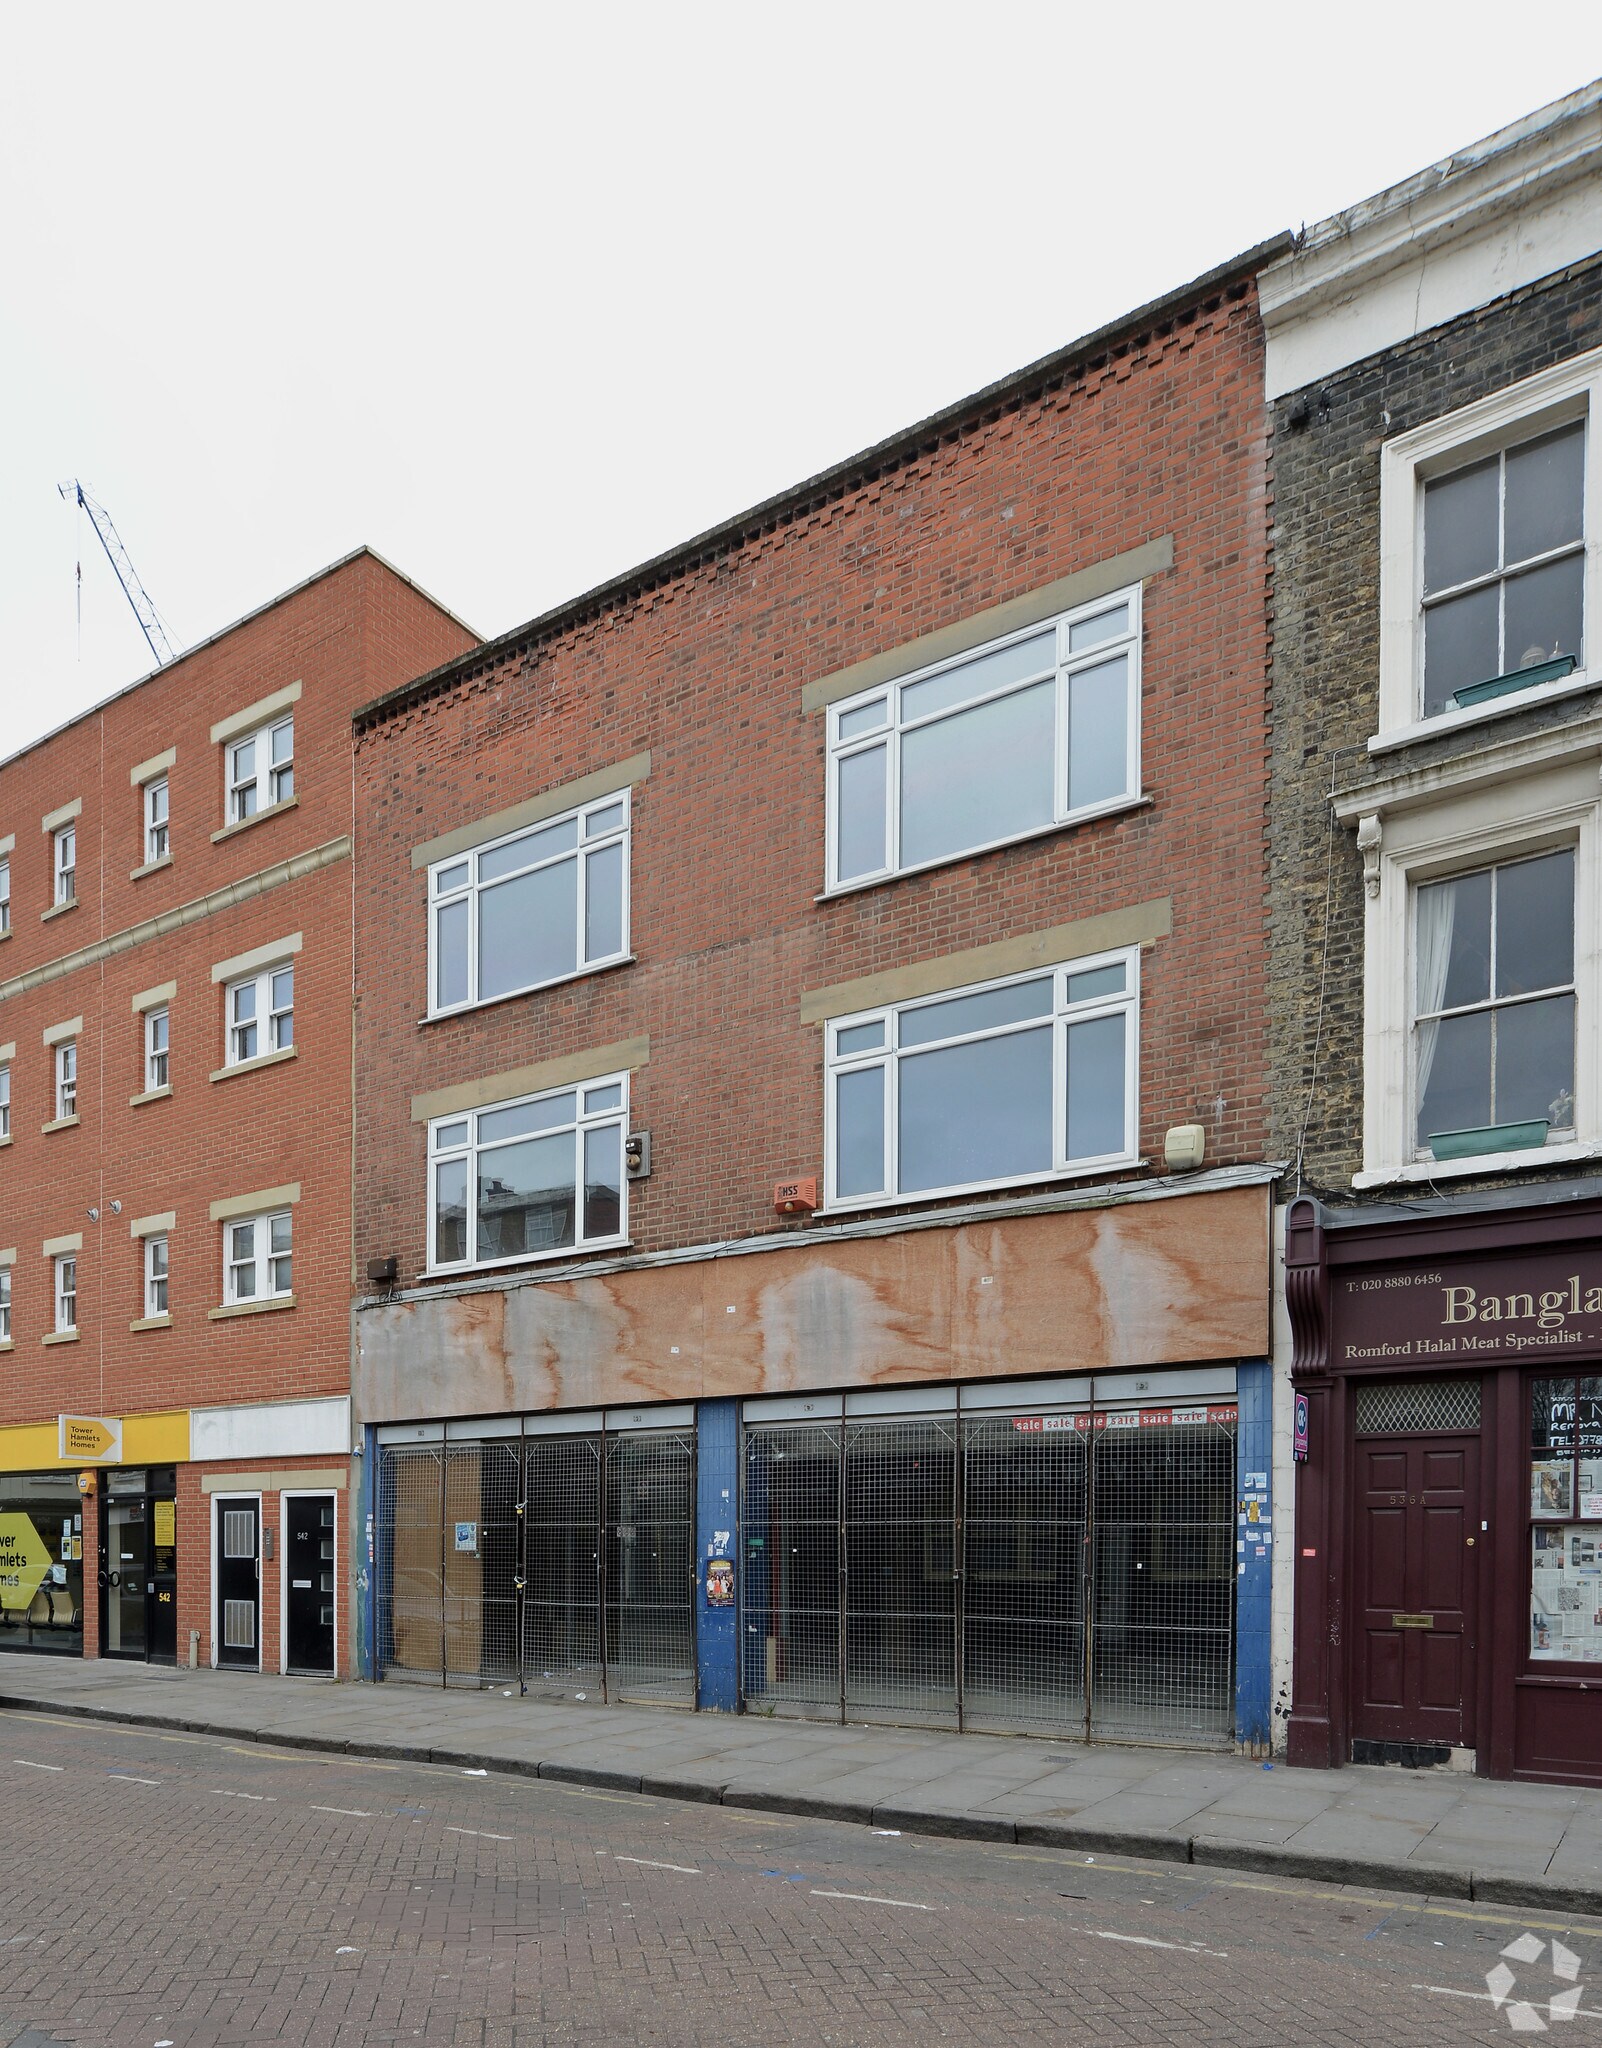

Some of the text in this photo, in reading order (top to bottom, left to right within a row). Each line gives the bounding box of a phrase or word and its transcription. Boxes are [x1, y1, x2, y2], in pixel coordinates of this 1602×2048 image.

[782, 1184, 799, 1197] HSS
[1346, 1273, 1442, 1292] T: 020 8880 6456
[1440, 1275, 1602, 1329] Bangla
[1345, 1342, 1412, 1358] Romford
[1415, 1337, 1457, 1354] Halal
[1461, 1335, 1501, 1350] Meat
[1505, 1330, 1583, 1350] Specialist
[1016, 1419, 1041, 1431] sale
[1047, 1418, 1071, 1429] sale
[1111, 1414, 1136, 1425] sale
[1143, 1412, 1169, 1424] sale
[1177, 1410, 1203, 1422] sale
[71, 1426, 94, 1434] Tower
[71, 1433, 101, 1442] Hamlets
[71, 1440, 96, 1449] Homes
[1390, 1495, 1427, 1505] 536A
[296, 1531, 309, 1541] 542
[158, 1592, 171, 1603] 542
